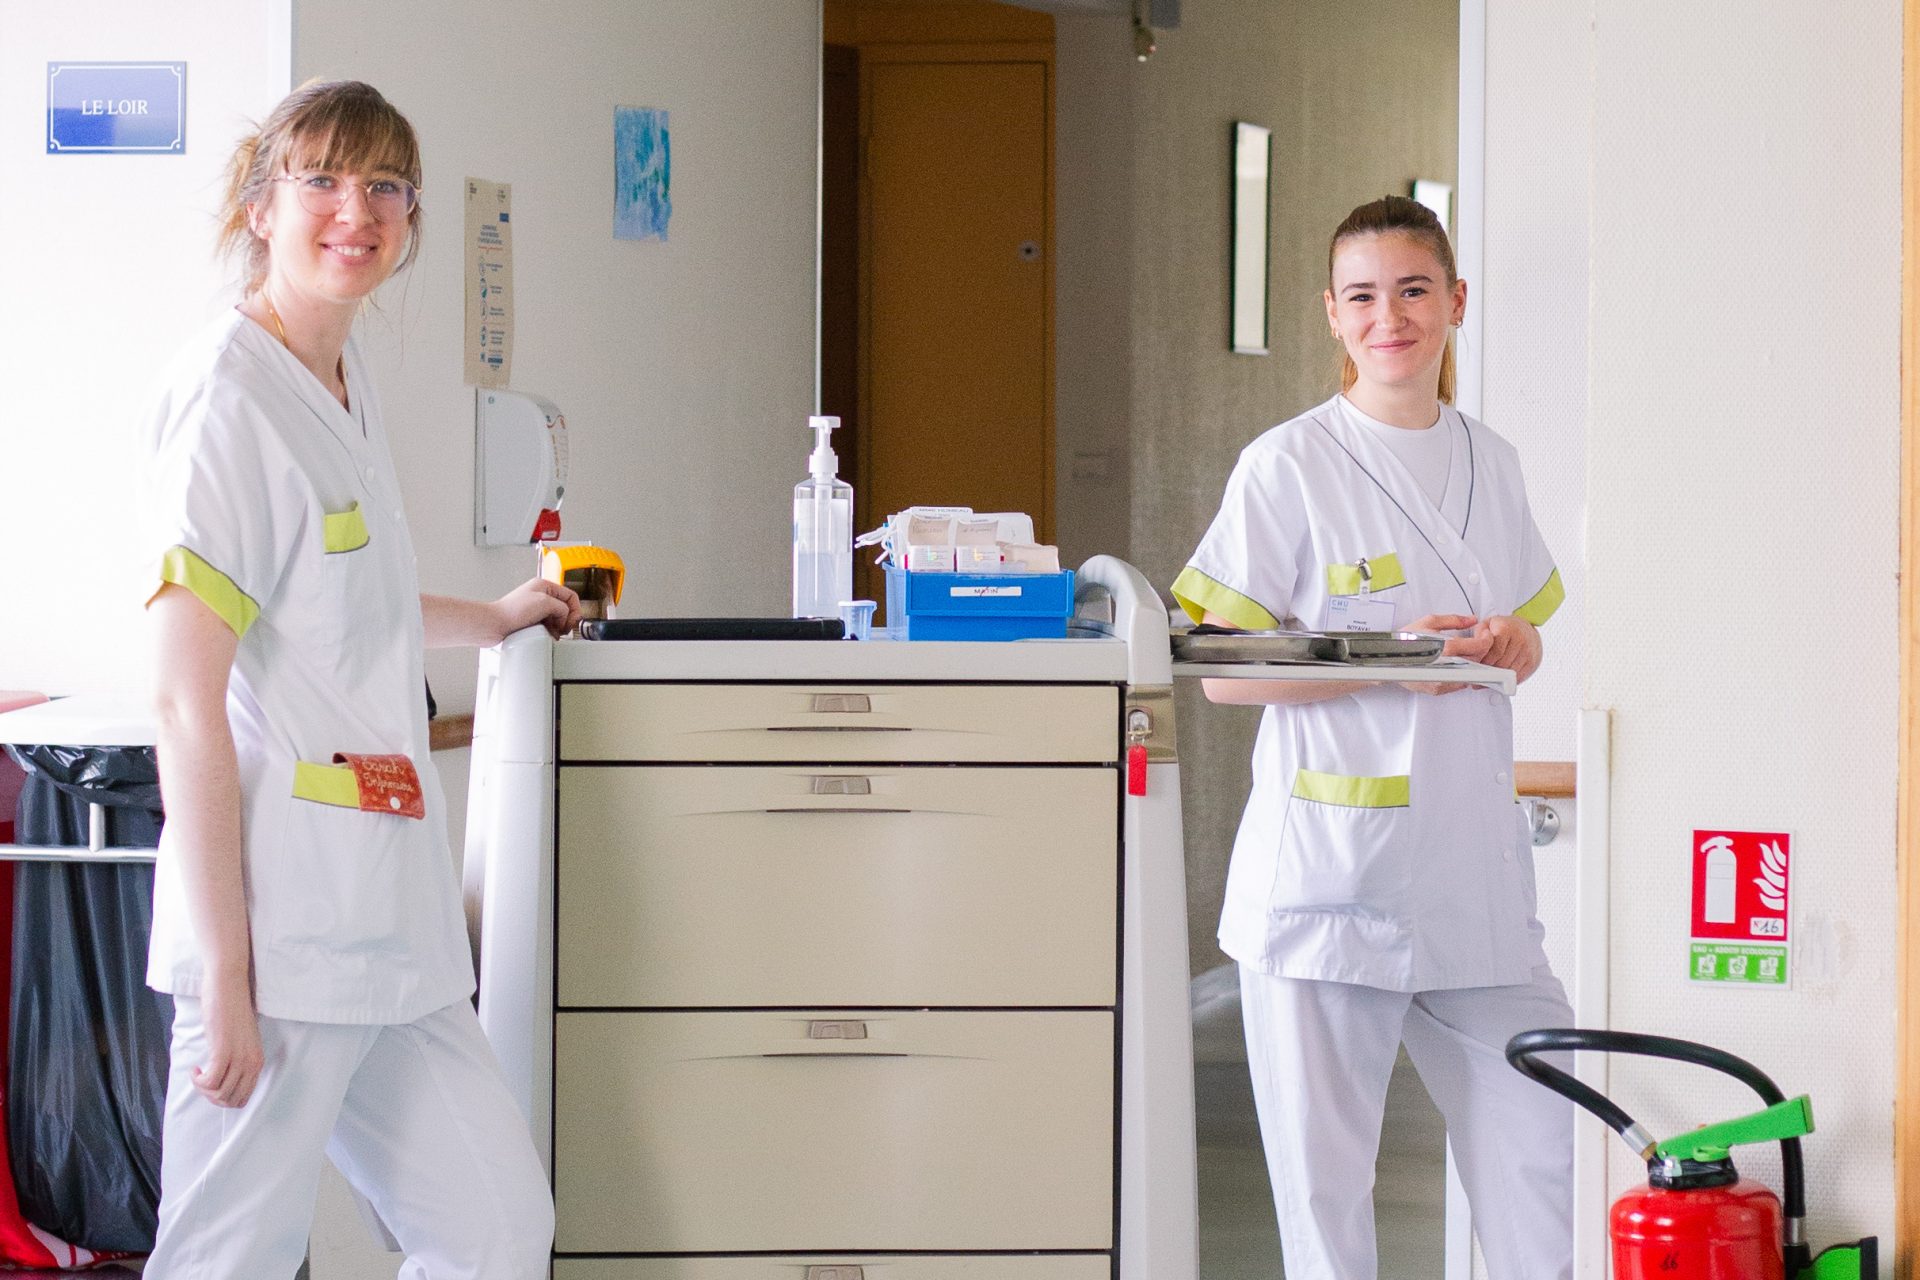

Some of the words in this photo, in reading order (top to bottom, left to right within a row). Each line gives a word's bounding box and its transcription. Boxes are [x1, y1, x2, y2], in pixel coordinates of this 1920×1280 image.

[82, 99, 104, 115] LE
[107, 99, 148, 115] LOIR
[361, 756, 405, 775] Sarah
